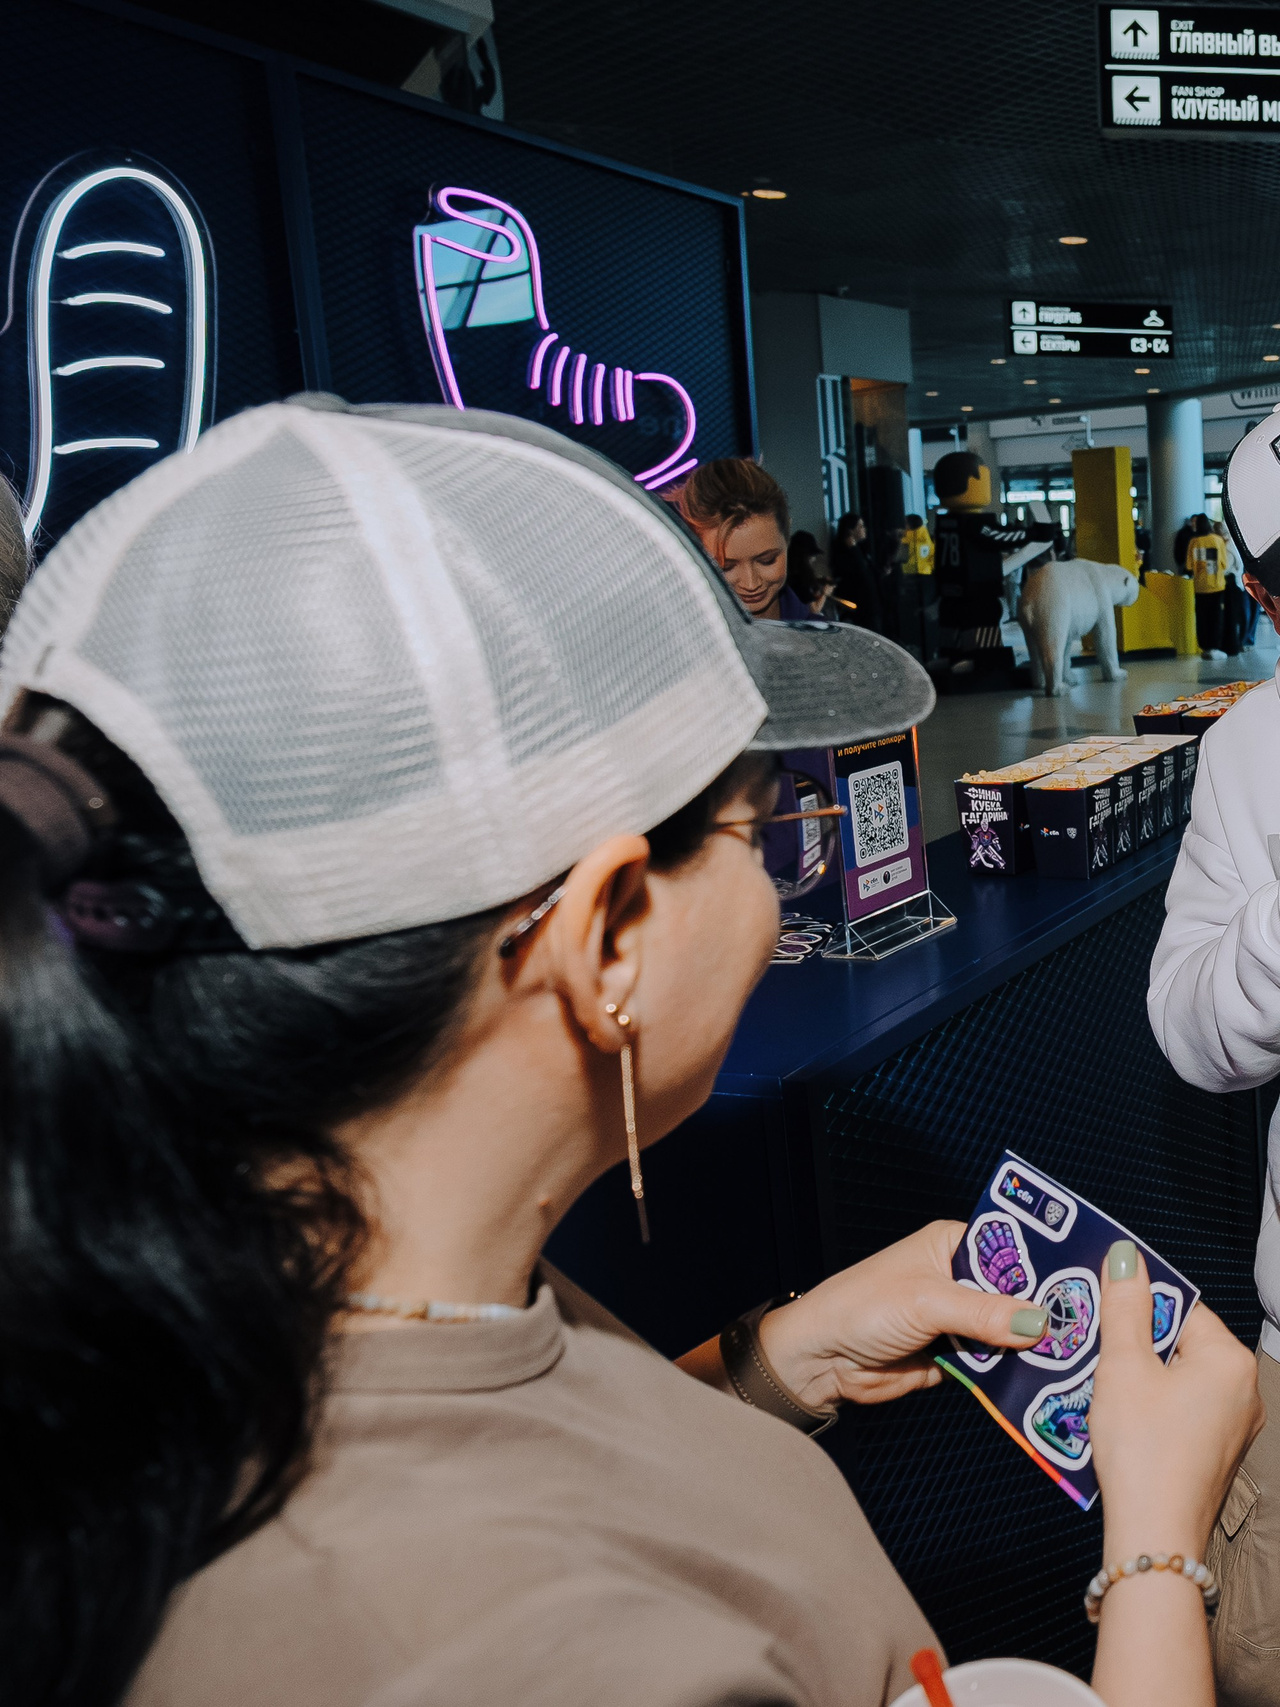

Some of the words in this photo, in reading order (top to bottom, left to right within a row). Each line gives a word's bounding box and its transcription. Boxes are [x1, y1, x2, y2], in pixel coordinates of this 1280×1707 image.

[1170, 20, 1194, 31] EXIT
[1170, 29, 1255, 56] ГЛАВНЫЙ
[1171, 86, 1194, 97] FAN
[1195, 86, 1225, 98] SHOP
[1171, 95, 1259, 122] КЛУБНЫЙ
[843, 741, 877, 756] получите
[877, 733, 907, 747] попкорн
[963, 787, 1002, 802] ФИНАЛ
[971, 799, 1004, 812] КУБКА
[961, 811, 1009, 825] ГАГАРИНА
